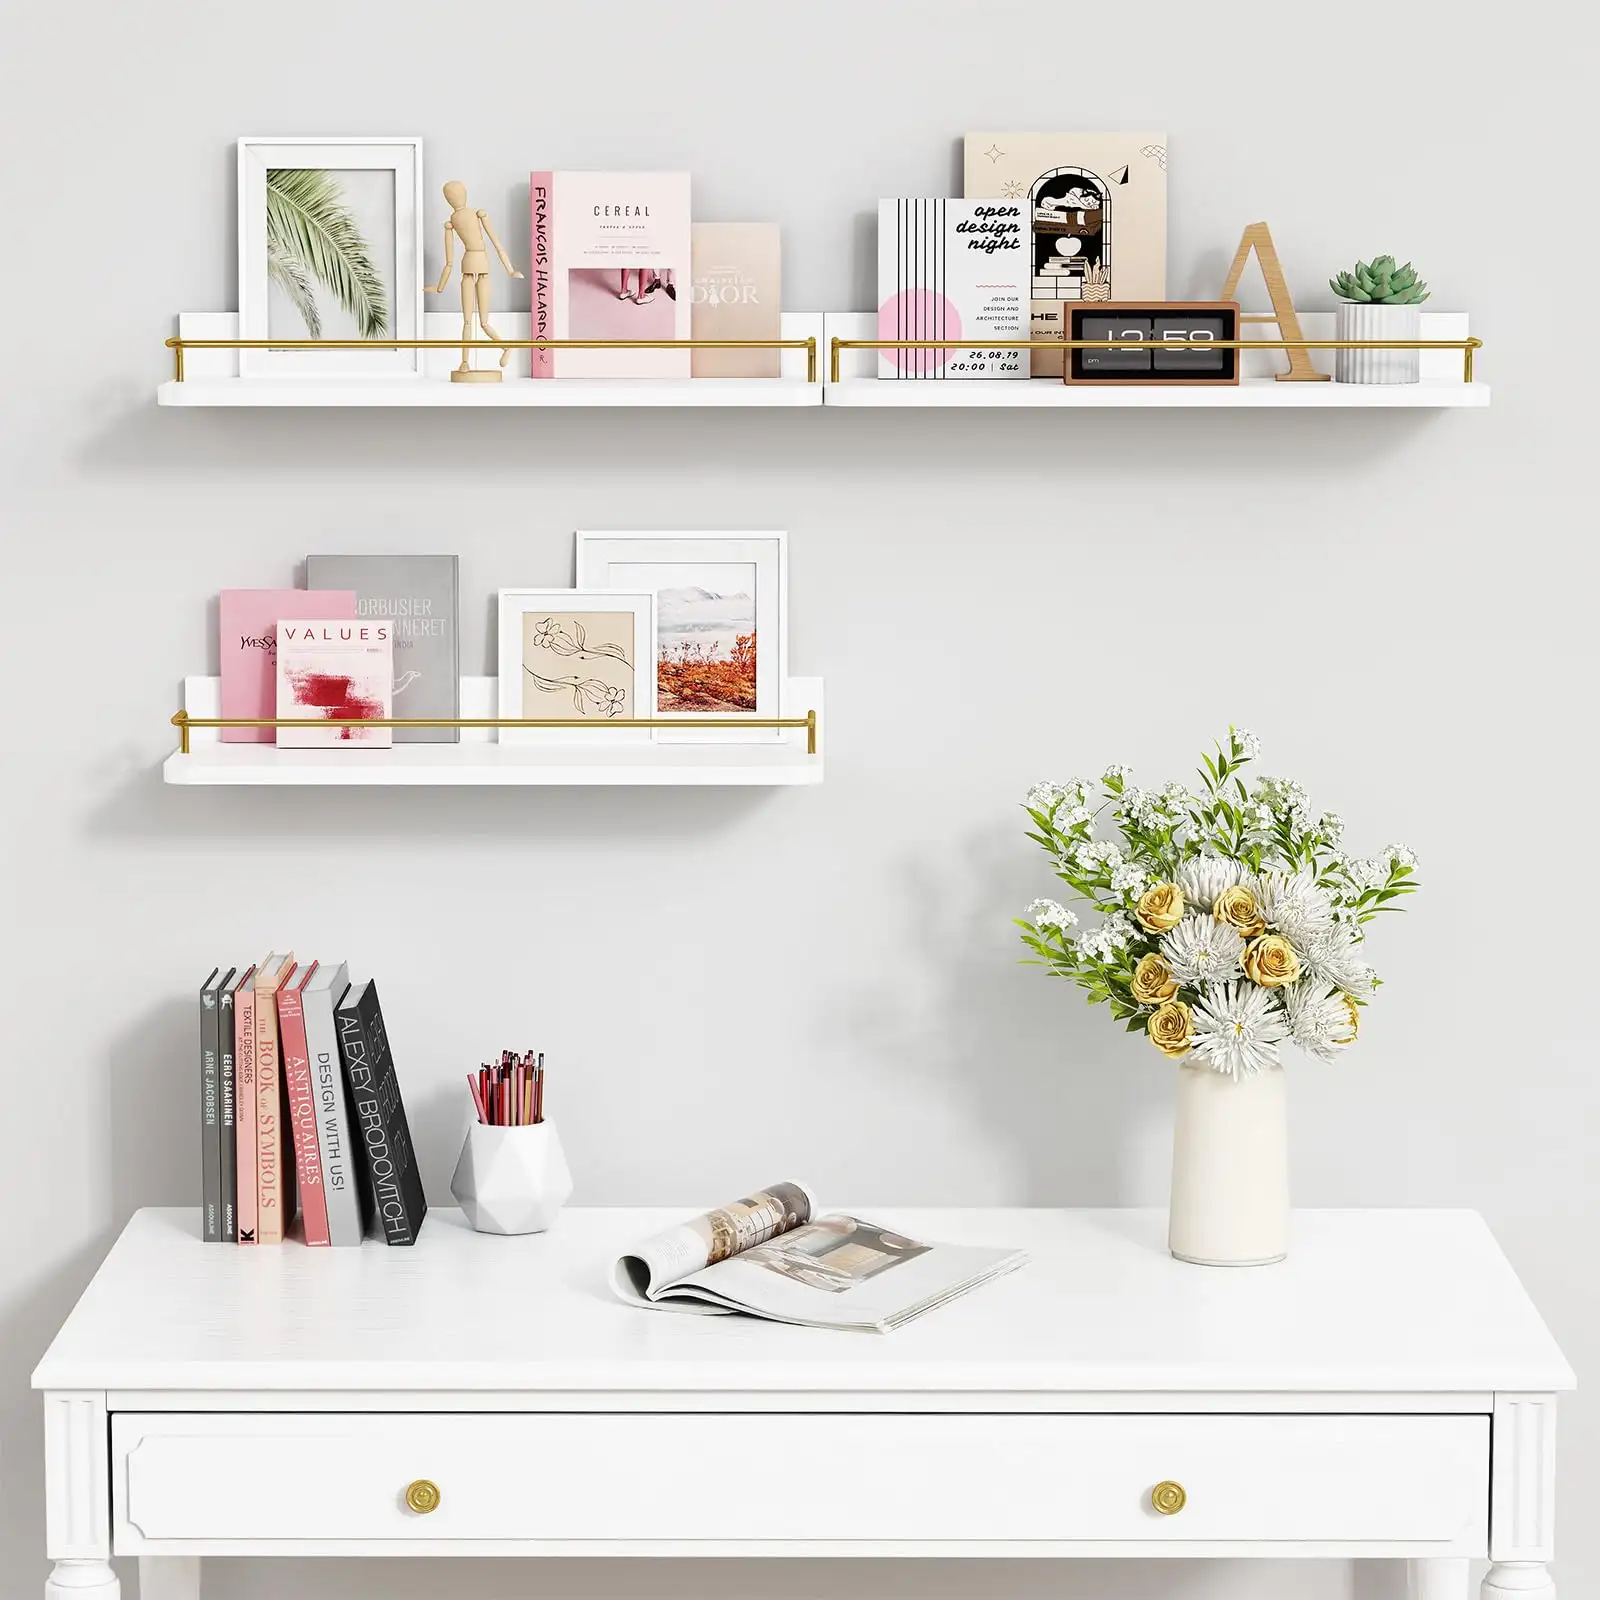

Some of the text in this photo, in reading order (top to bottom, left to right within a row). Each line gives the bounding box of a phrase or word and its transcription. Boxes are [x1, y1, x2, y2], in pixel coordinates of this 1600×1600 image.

[535, 187, 548, 265] FRANÇOIS
[593, 205, 650, 217] CEREAL
[956, 219, 1021, 238] design
[974, 205, 1021, 221] open
[967, 236, 1021, 254] night
[535, 270, 548, 333] HALARD
[950, 363, 1020, 371] 20:00 Sat
[1108, 330, 1143, 351] 12
[285, 628, 387, 640] VALUES
[354, 598, 432, 616] ORBUSIER
[243, 1005, 253, 1084] TEXTILE DESIGNERS
[205, 1050, 215, 1125] ARNE JACOBSEN
[223, 1054, 233, 1126] EERO SAARINEN
[258, 1019, 276, 1208] THE BOOK OF SYMBOLS
[292, 1056, 320, 1185] ANTIQUAIRES
[317, 1052, 344, 1191] DESIGN WITH US!
[338, 1016, 374, 1093] ALEXEY
[358, 1100, 406, 1233] BRODOVITCH
